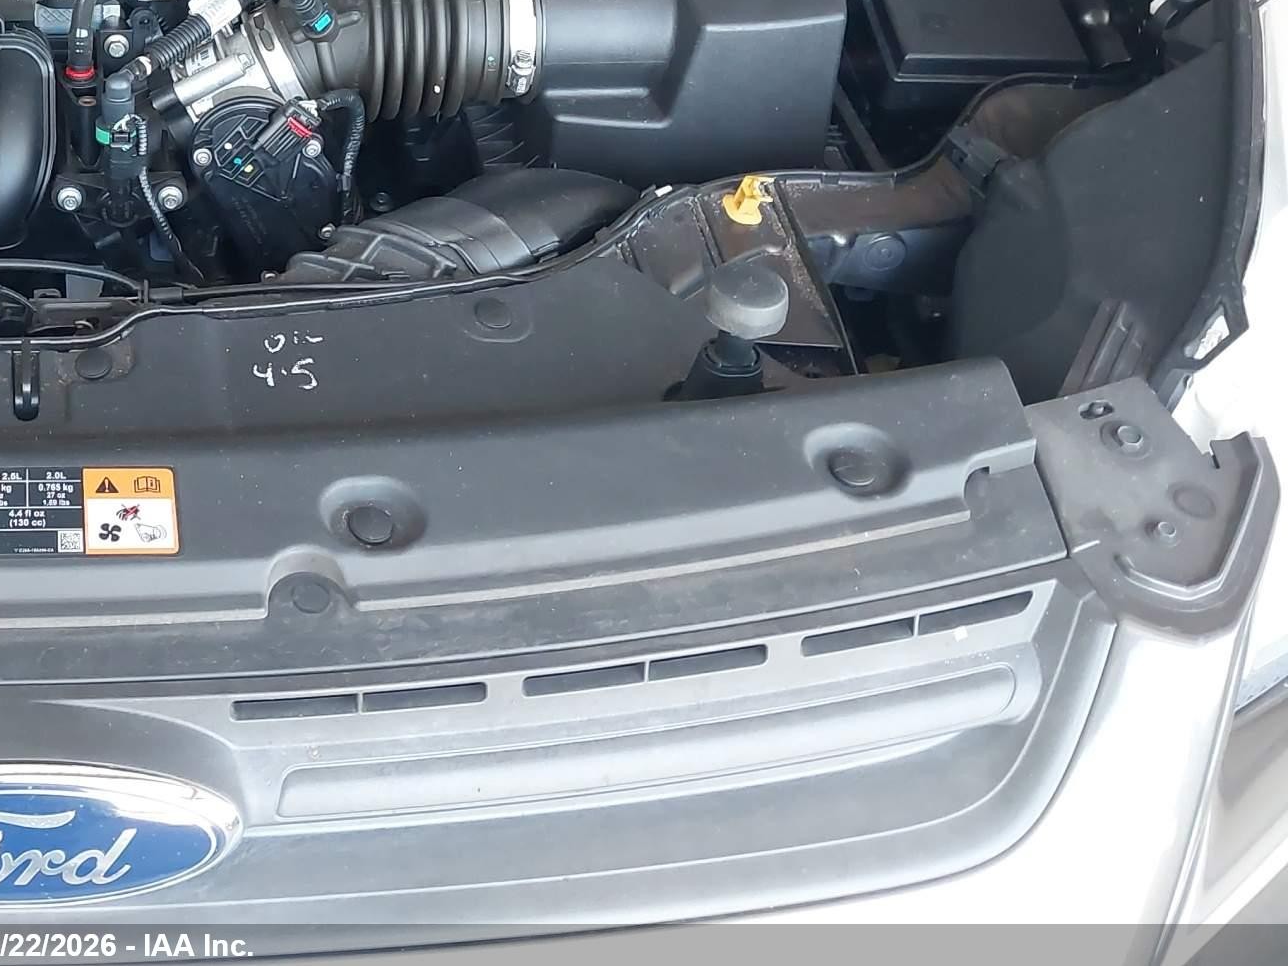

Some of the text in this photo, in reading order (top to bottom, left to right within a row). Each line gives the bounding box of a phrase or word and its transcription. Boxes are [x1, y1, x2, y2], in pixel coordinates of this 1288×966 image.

[46, 471, 67, 480] 2.0L
[0, 484, 13, 494] kg
[62, 483, 74, 493] kg
[46, 491, 56, 499] 27
[8, 509, 46, 519] 4.4 fl oz
[8, 518, 47, 528] (130 cc)
